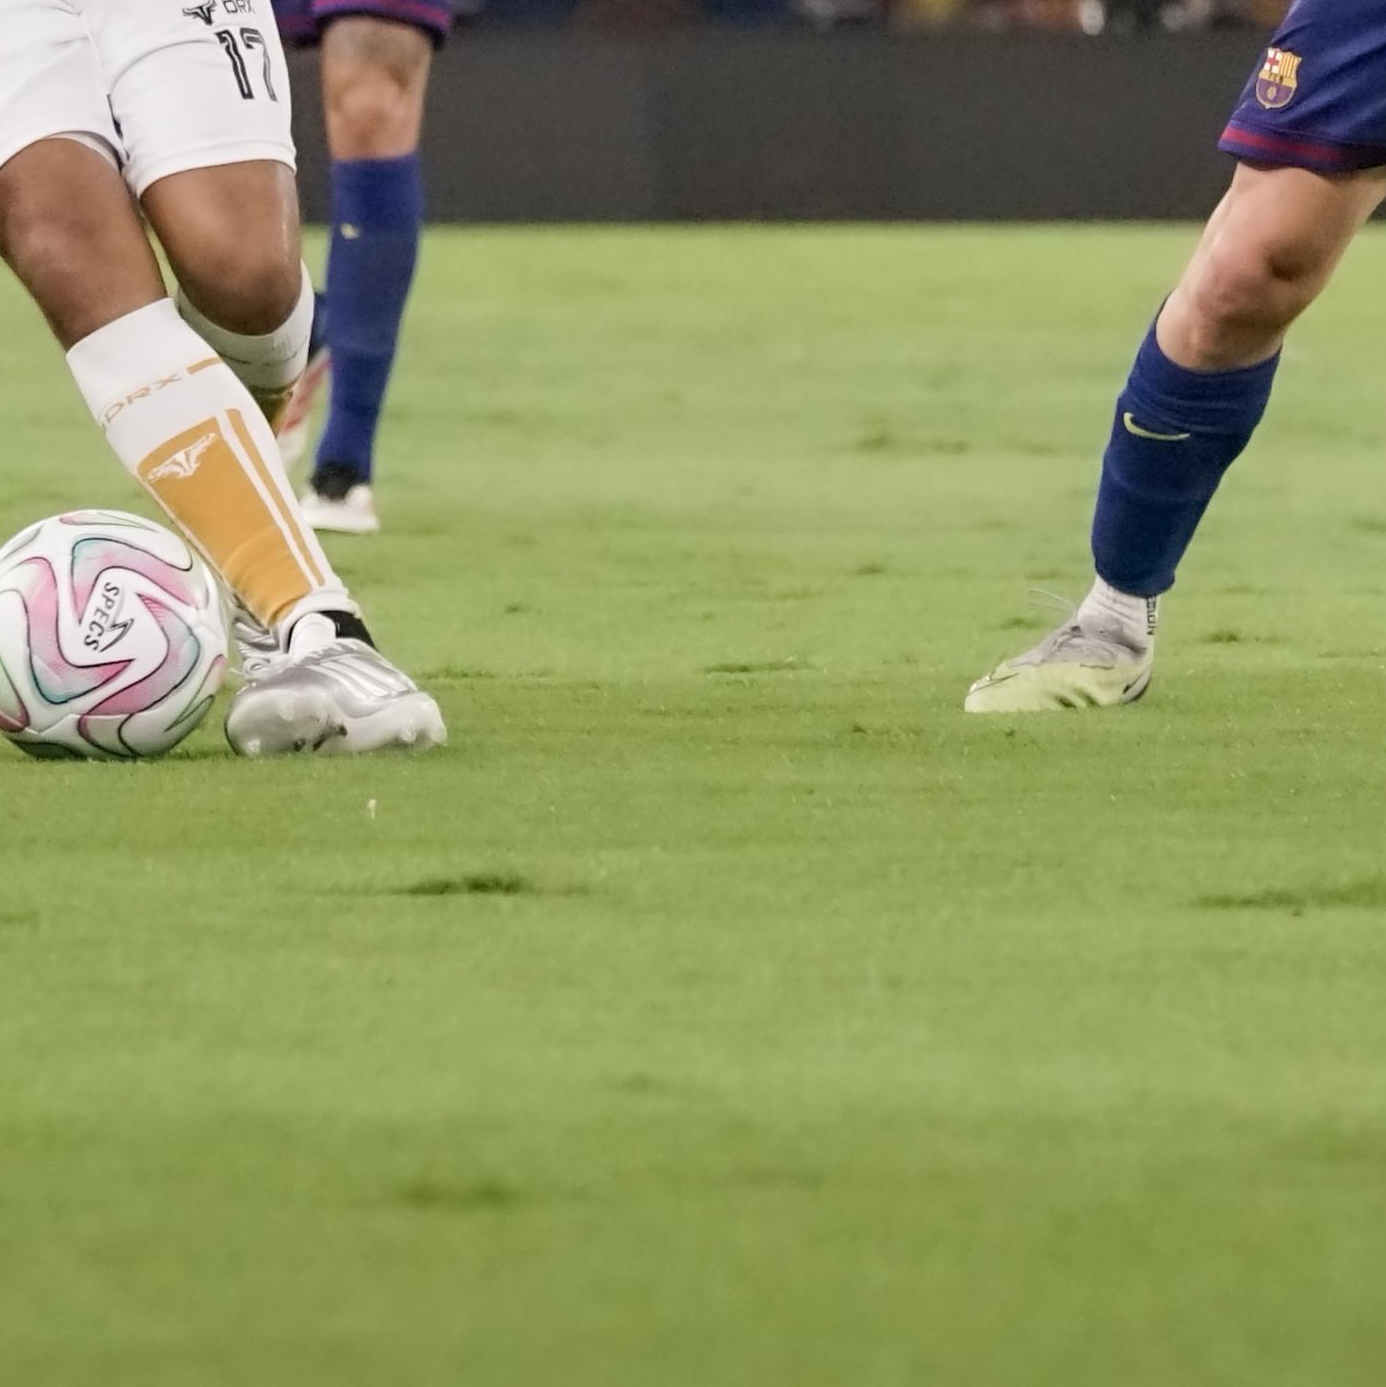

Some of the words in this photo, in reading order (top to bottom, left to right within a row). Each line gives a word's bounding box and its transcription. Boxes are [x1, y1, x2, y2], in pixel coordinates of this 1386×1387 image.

[213, 27, 278, 102] 17
[104, 373, 182, 424] DRX
[83, 581, 120, 651] SPECS
